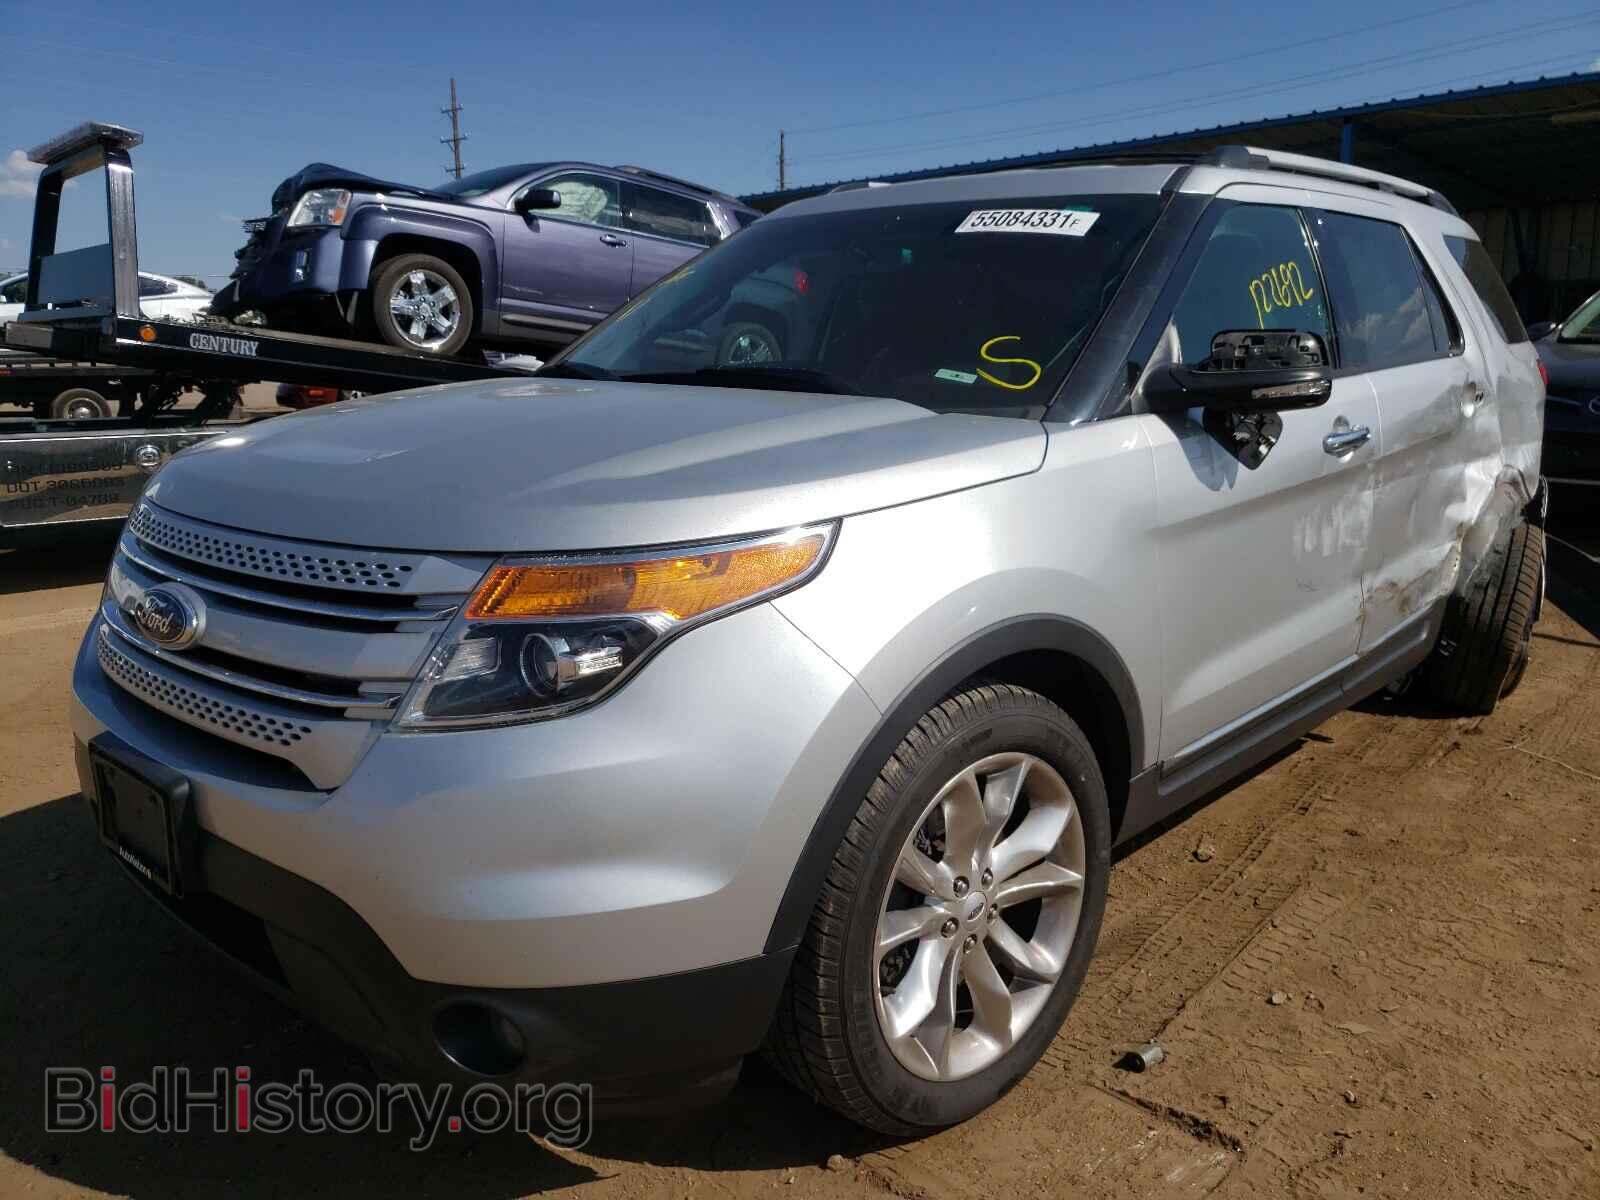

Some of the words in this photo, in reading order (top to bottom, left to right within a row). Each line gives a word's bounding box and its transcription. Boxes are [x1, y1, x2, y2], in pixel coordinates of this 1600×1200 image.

[189, 333, 259, 356] CENTURY
[976, 335, 1042, 390] S
[7, 480, 40, 493] DOT
[137, 595, 176, 634] Ford
